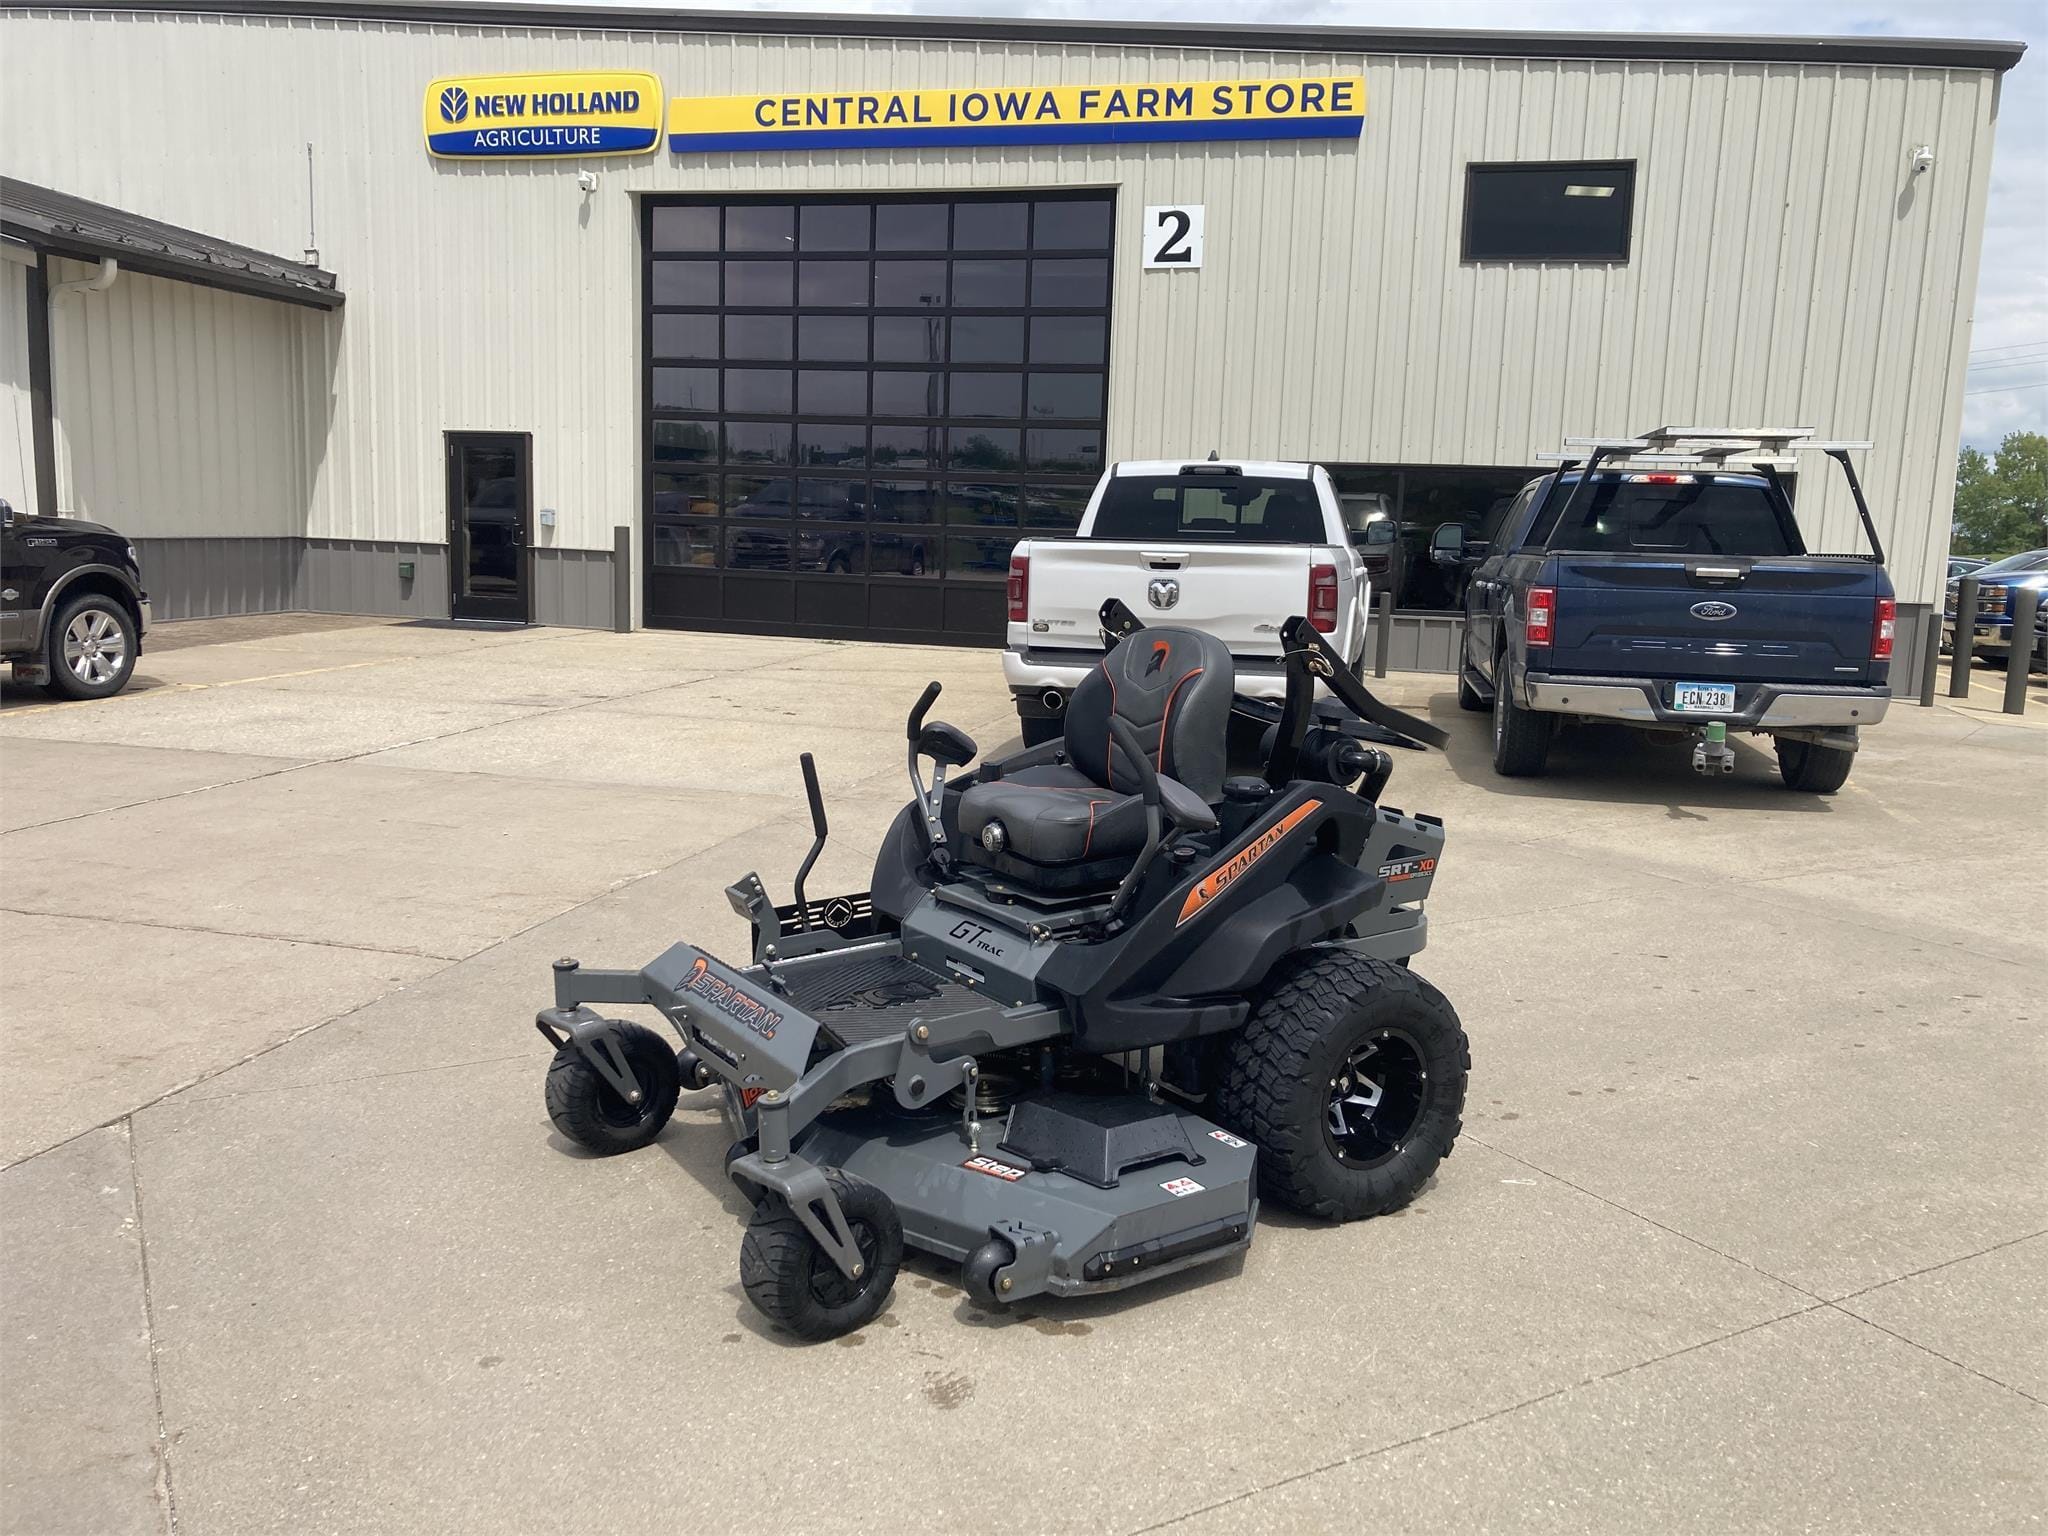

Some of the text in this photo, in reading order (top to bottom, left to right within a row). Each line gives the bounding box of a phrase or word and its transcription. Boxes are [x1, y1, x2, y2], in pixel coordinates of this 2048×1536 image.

[475, 90, 640, 117] NEW HOLLAND
[754, 82, 1354, 127] CENTRAL IOWA FARM STORE
[474, 127, 601, 147] AGRICULTURE
[1153, 209, 1192, 263] 2
[1700, 604, 1727, 616] Ford
[1682, 691, 1726, 706] ECN 238
[1215, 824, 1284, 890] SPARTAN
[1378, 859, 1435, 878] SRT-XD
[949, 920, 992, 944] GT
[976, 940, 1005, 957] TRAC
[691, 971, 783, 1036] SPARTAN
